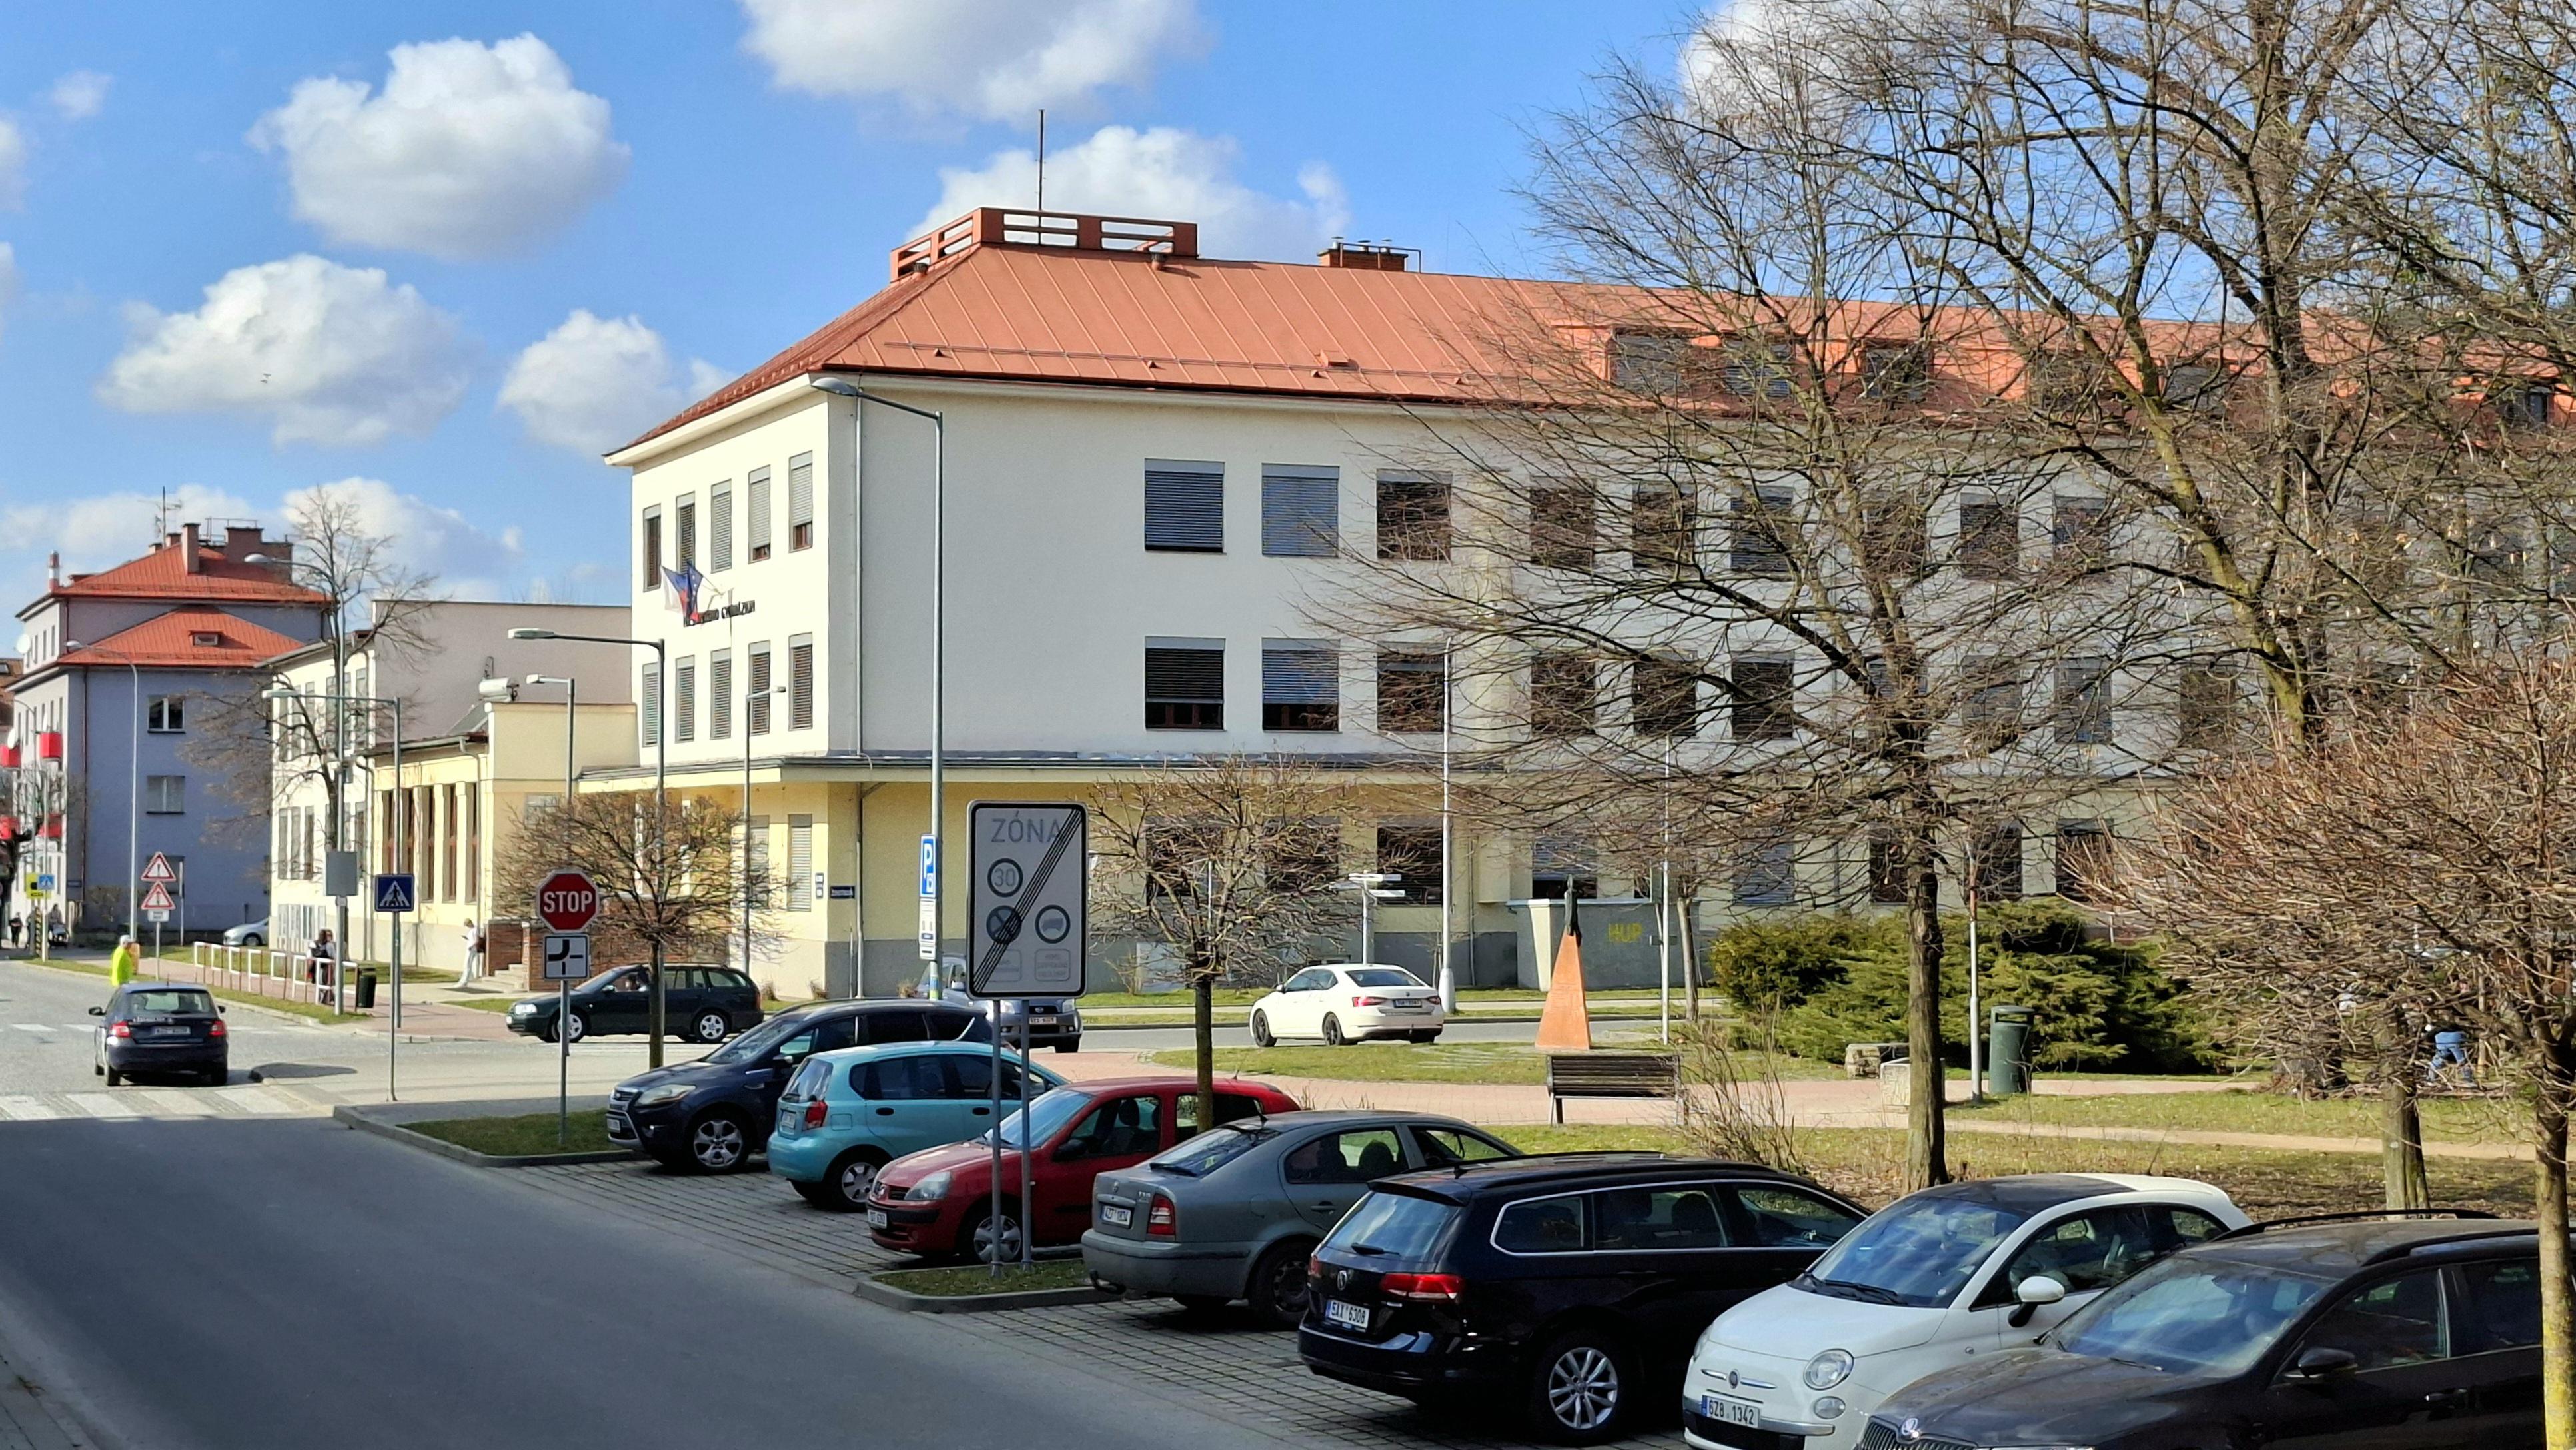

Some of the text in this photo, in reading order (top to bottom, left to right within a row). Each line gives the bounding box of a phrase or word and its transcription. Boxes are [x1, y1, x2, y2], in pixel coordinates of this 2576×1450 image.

[991, 810, 1062, 844] ZÓNA
[924, 842, 933, 879] P
[993, 868, 1016, 888] 30
[543, 890, 593, 913] STOP
[1709, 1399, 1754, 1425] 6Z8 1342
